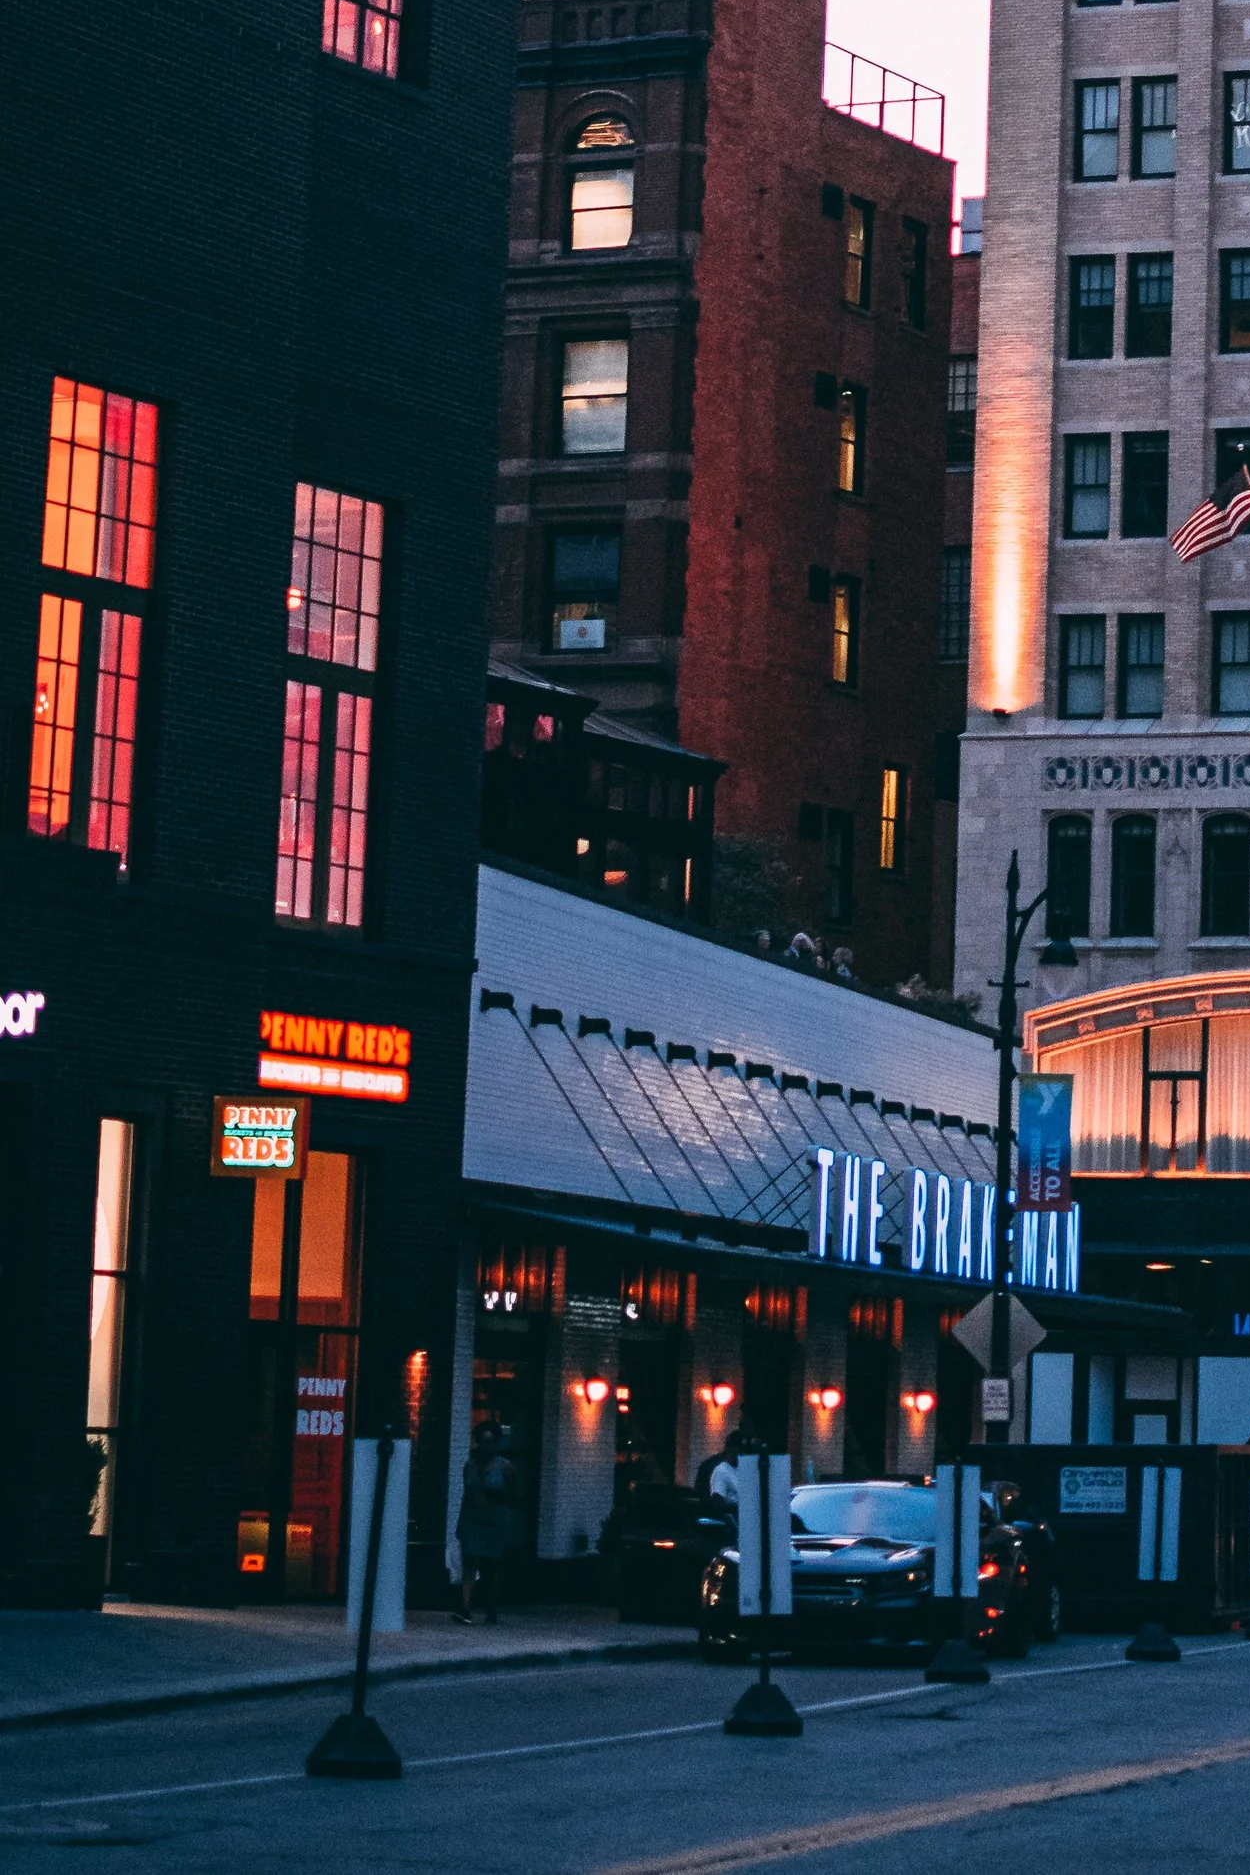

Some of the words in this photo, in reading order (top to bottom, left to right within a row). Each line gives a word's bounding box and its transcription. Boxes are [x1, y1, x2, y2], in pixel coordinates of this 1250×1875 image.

[0, 991, 45, 1036] or
[345, 1022, 411, 1067] RED'S
[223, 1107, 296, 1129] PENNY
[222, 1136, 294, 1165] RED'S
[1045, 1176, 1061, 1202] TO
[817, 1147, 886, 1265] THE
[910, 1168, 1080, 1293] BRAKMAN
[298, 1377, 347, 1397] PENNY
[296, 1409, 345, 1436] RED'S
